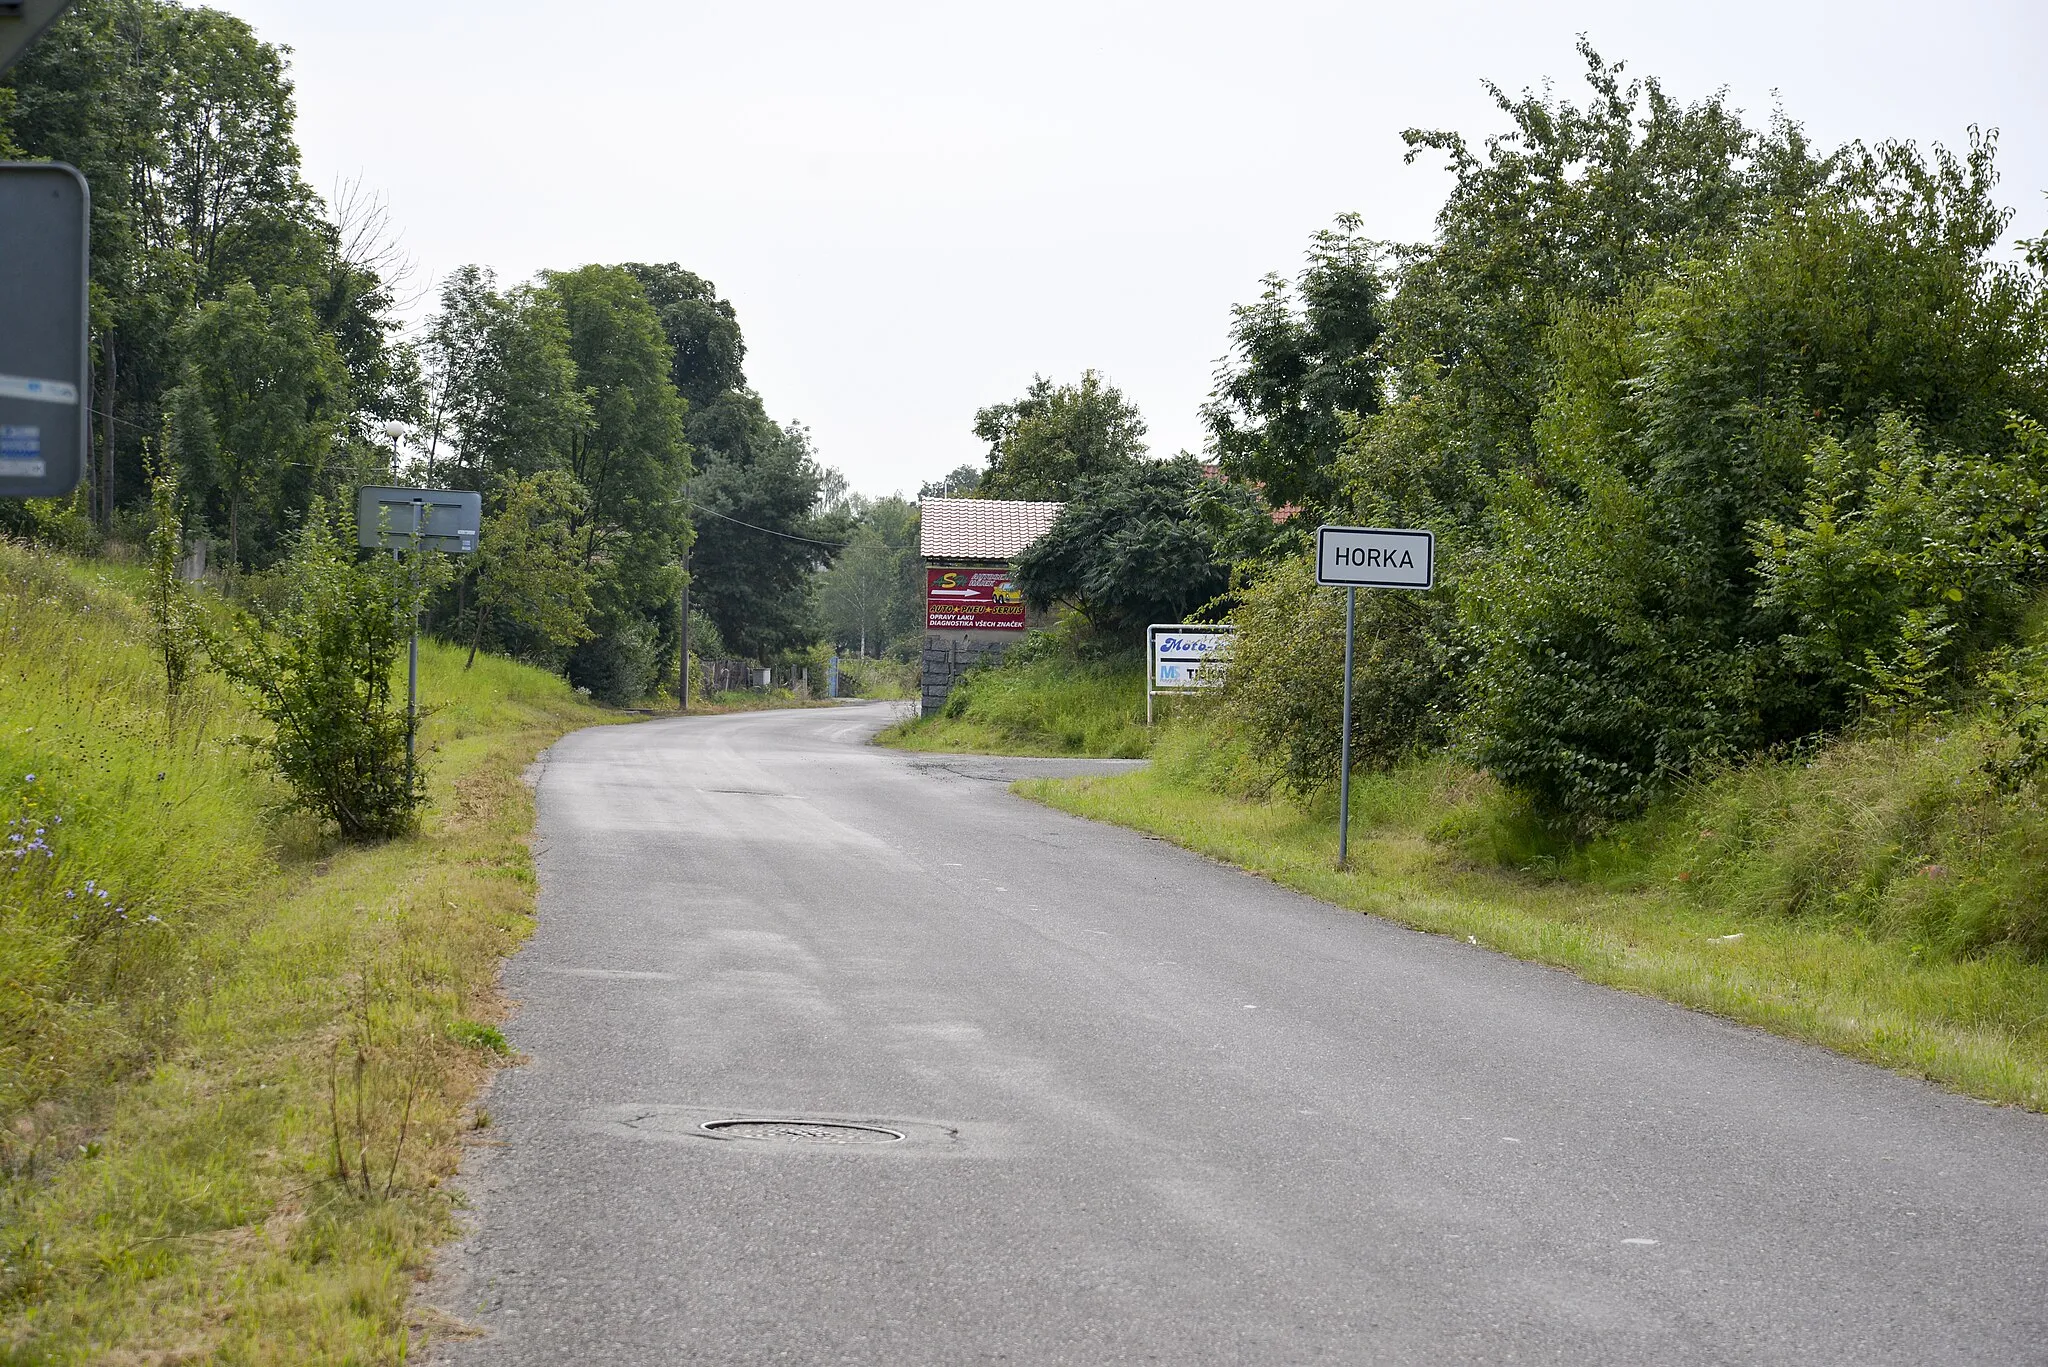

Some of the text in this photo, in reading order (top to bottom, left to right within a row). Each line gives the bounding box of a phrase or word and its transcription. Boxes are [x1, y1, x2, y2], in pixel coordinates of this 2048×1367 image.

[1335, 547, 1414, 569] HORKA
[929, 604, 1025, 615] AUTO PNEU SERVIS
[929, 613, 956, 621] OPRAVY
[975, 620, 996, 628] VŠECH
[996, 620, 1024, 628] ZNAČEK
[1160, 637, 1218, 653] Moto-
